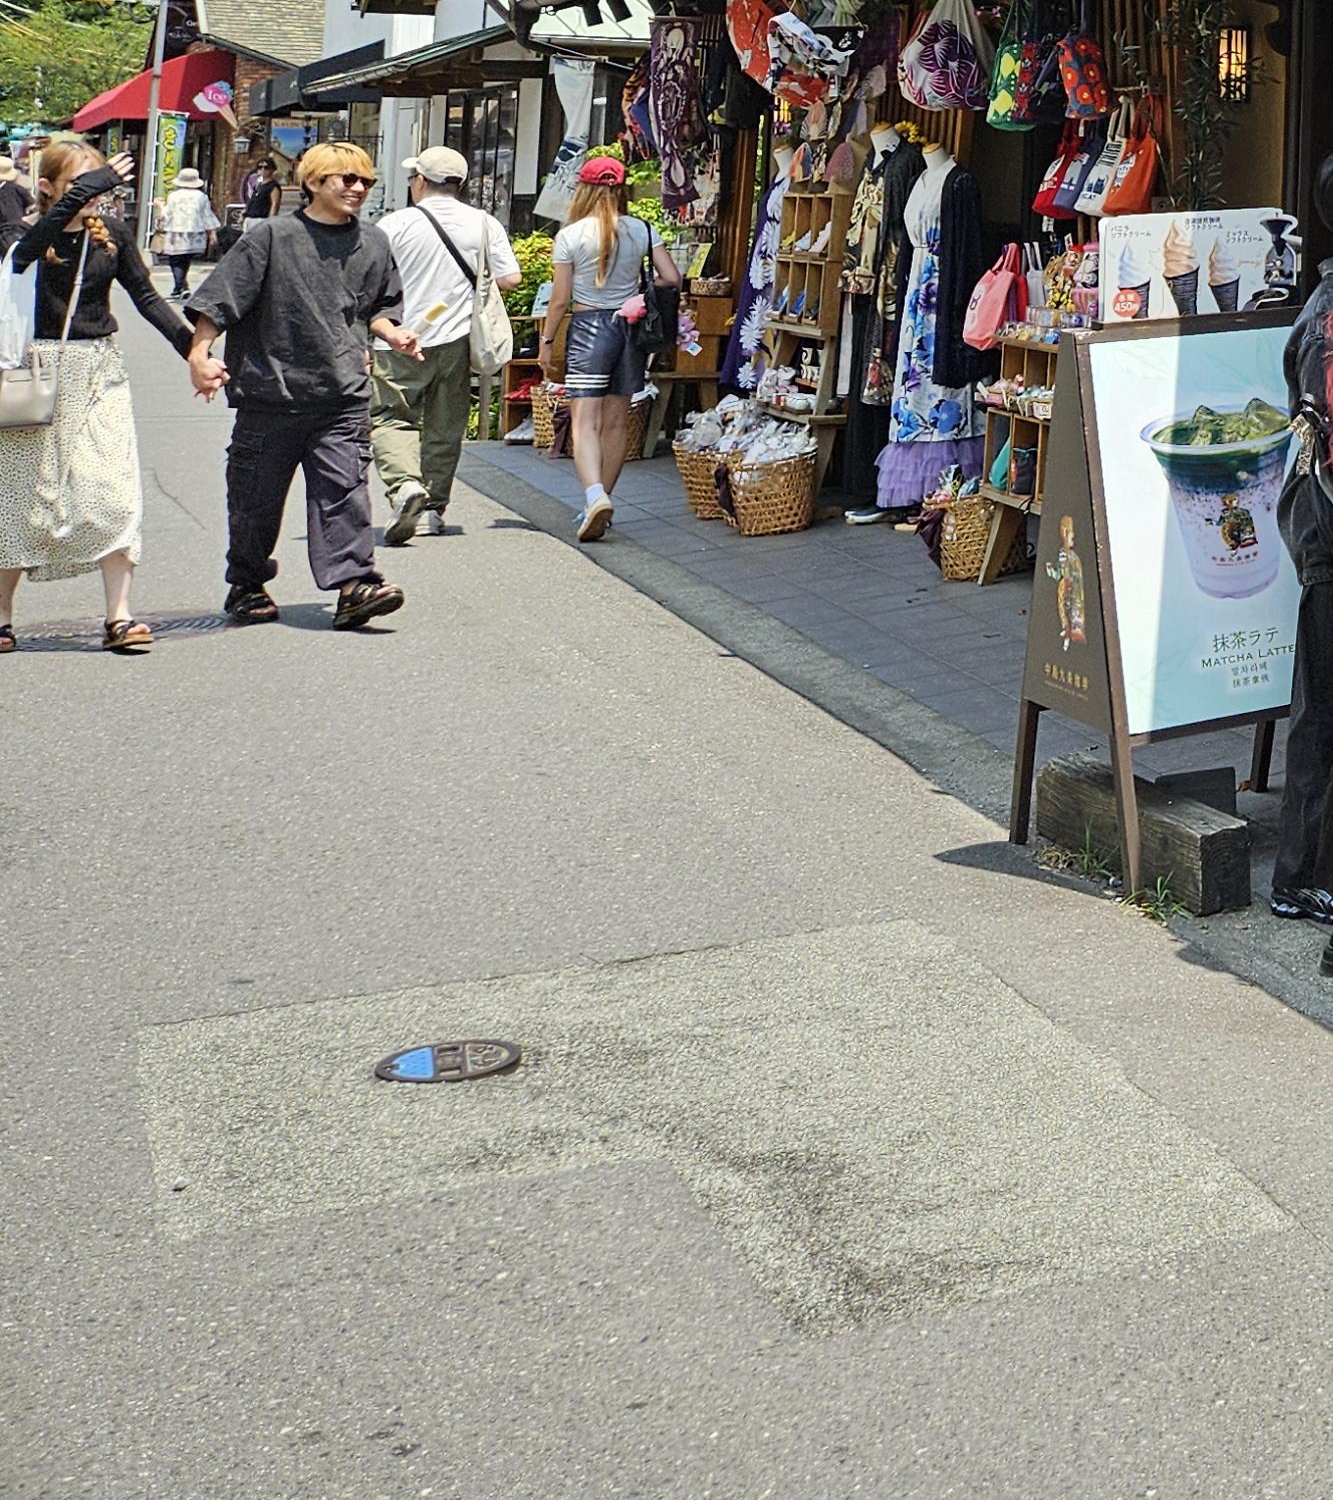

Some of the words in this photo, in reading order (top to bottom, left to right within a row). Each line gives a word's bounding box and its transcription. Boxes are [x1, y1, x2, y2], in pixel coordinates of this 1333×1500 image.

[1212, 626, 1279, 654] 抹茶ラテ
[1201, 652, 1254, 669] MATCHA
[1257, 644, 1296, 659] LATTE
